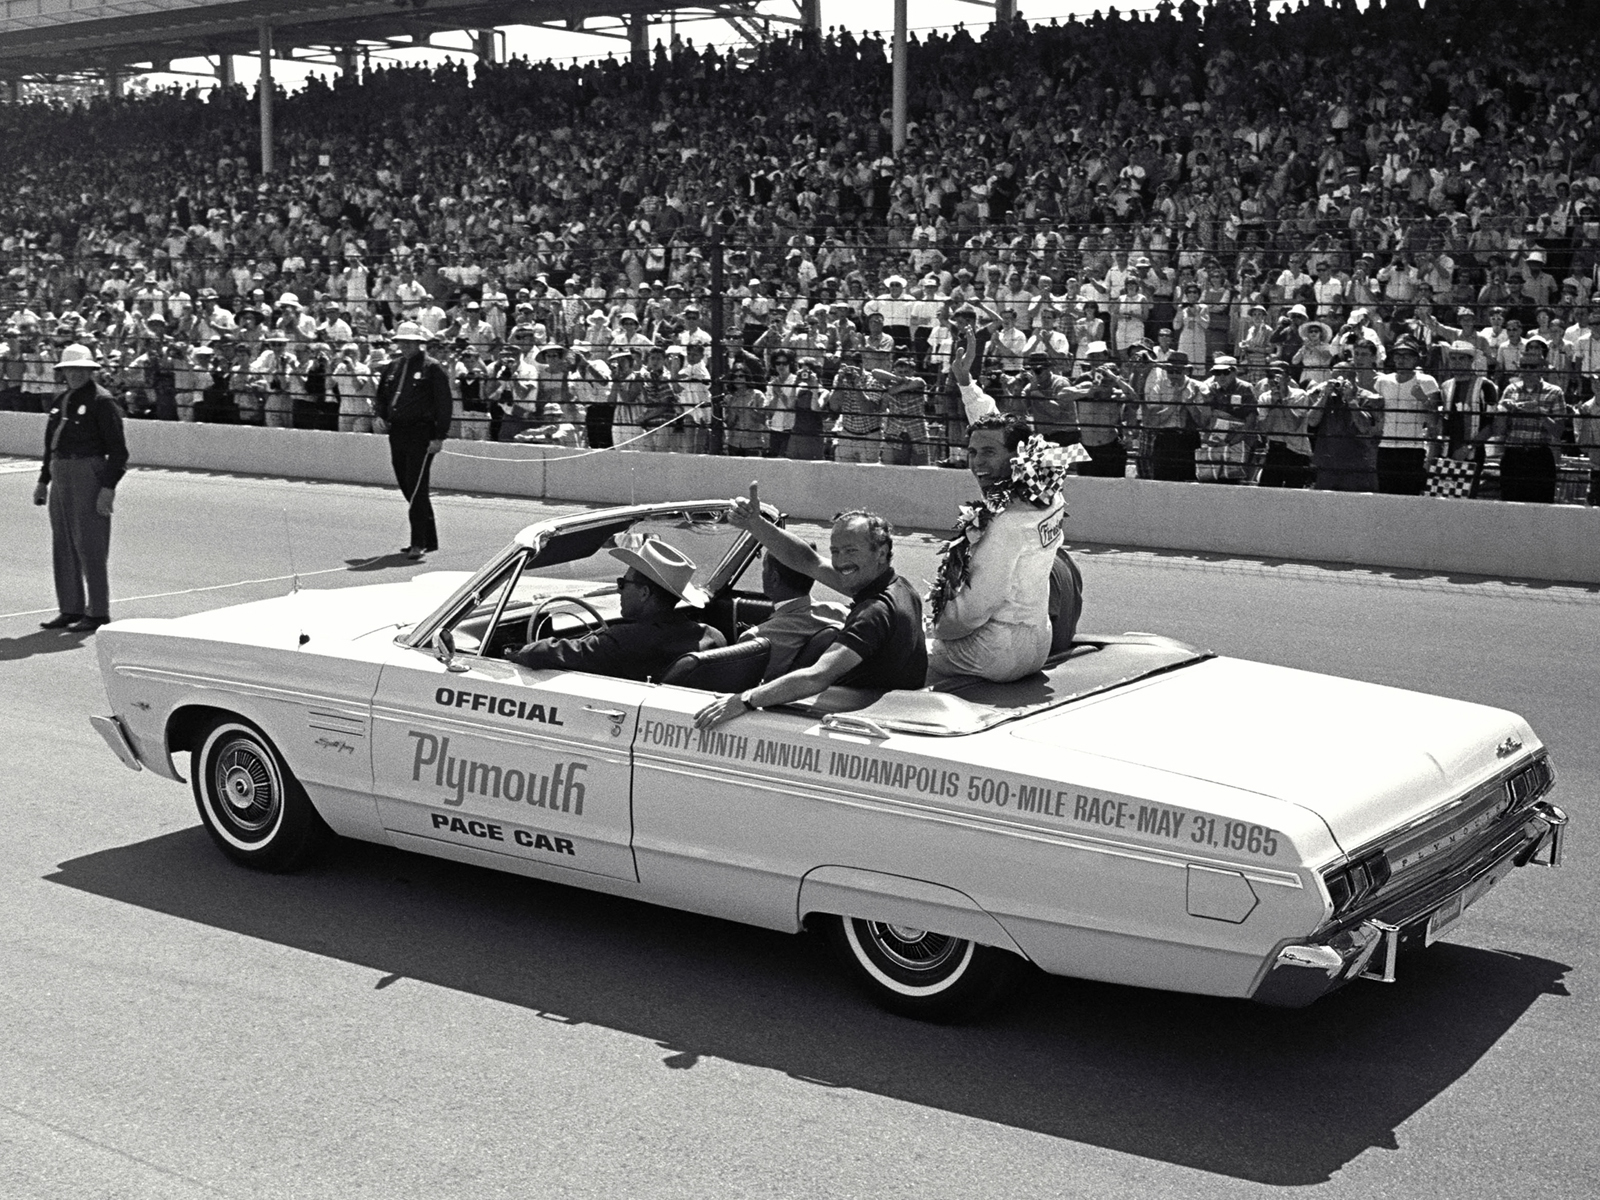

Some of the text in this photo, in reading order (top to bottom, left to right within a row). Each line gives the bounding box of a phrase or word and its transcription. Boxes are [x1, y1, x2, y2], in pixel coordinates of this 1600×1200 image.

[435, 688, 564, 726] OFFICIAL
[408, 730, 588, 816] Plymouth
[642, 720, 749, 761] FORTY-NINTH
[752, 739, 823, 774] ANNUAL
[829, 752, 960, 798] INDIANAPOLIS
[967, 775, 1068, 818] 500-MILE
[431, 813, 576, 856] PACE CAR
